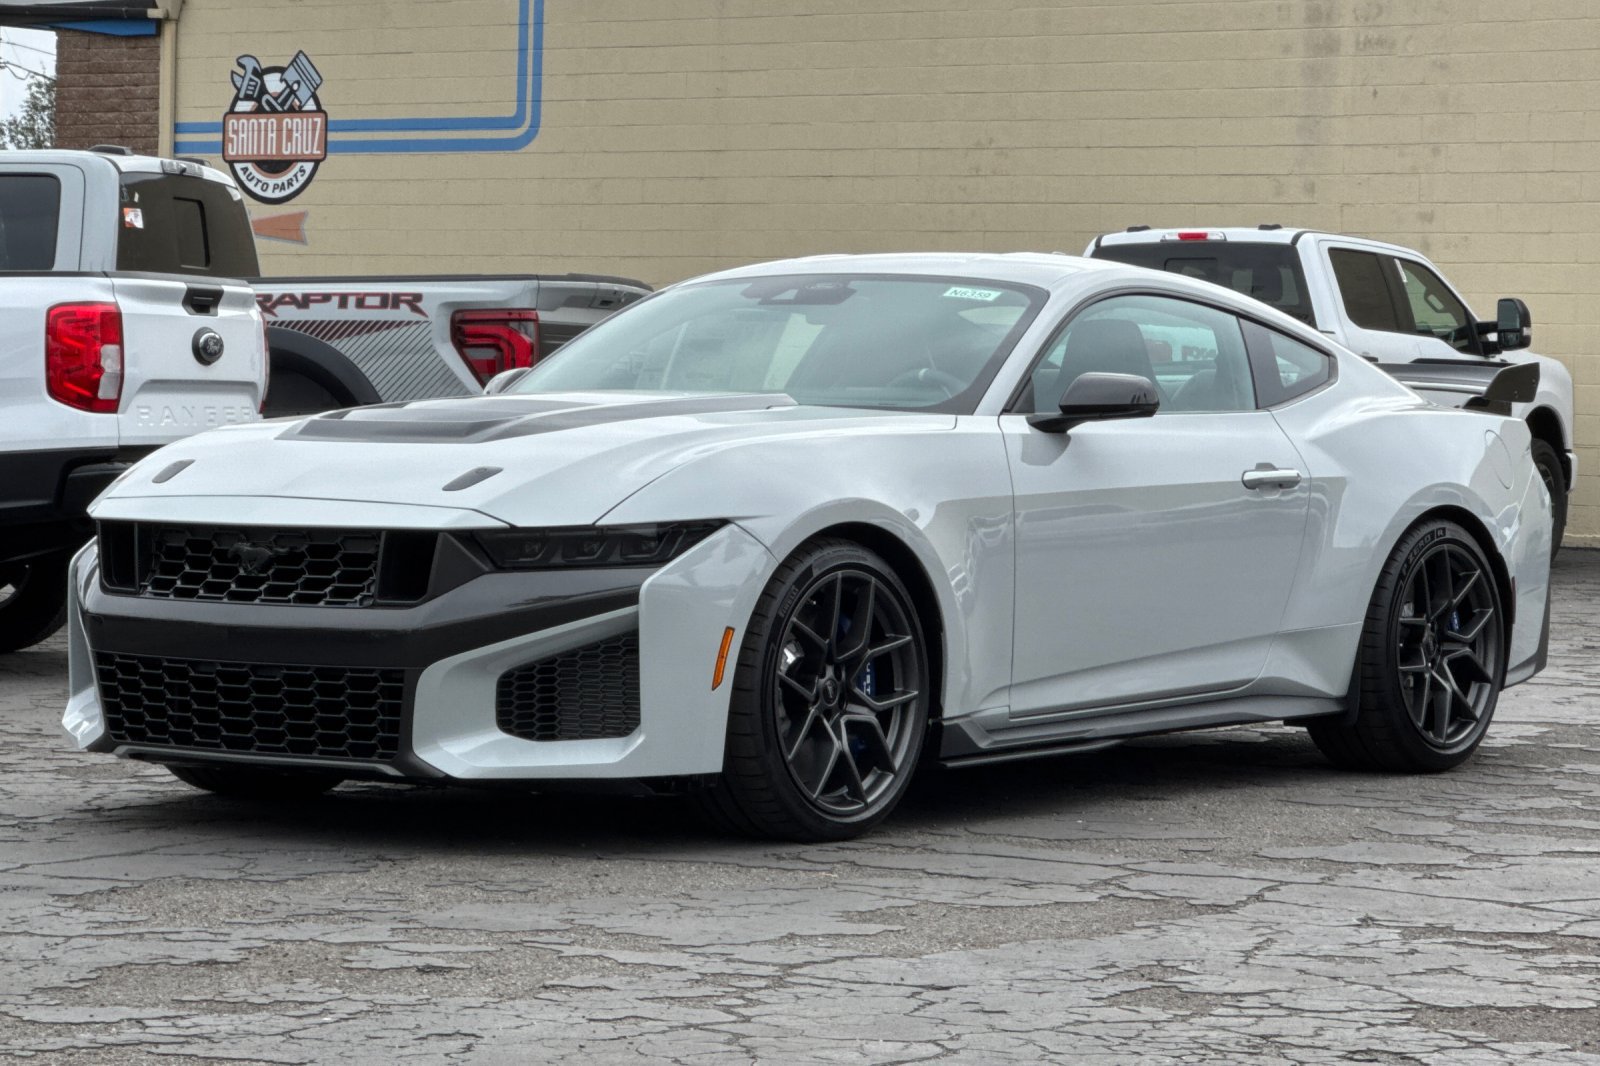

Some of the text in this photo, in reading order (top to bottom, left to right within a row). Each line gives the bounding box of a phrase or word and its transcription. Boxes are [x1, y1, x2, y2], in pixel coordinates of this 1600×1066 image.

[228, 118, 321, 155] SANTA CRUZ
[240, 165, 307, 193] AUTO PARTS
[256, 292, 429, 318] RAPTOR
